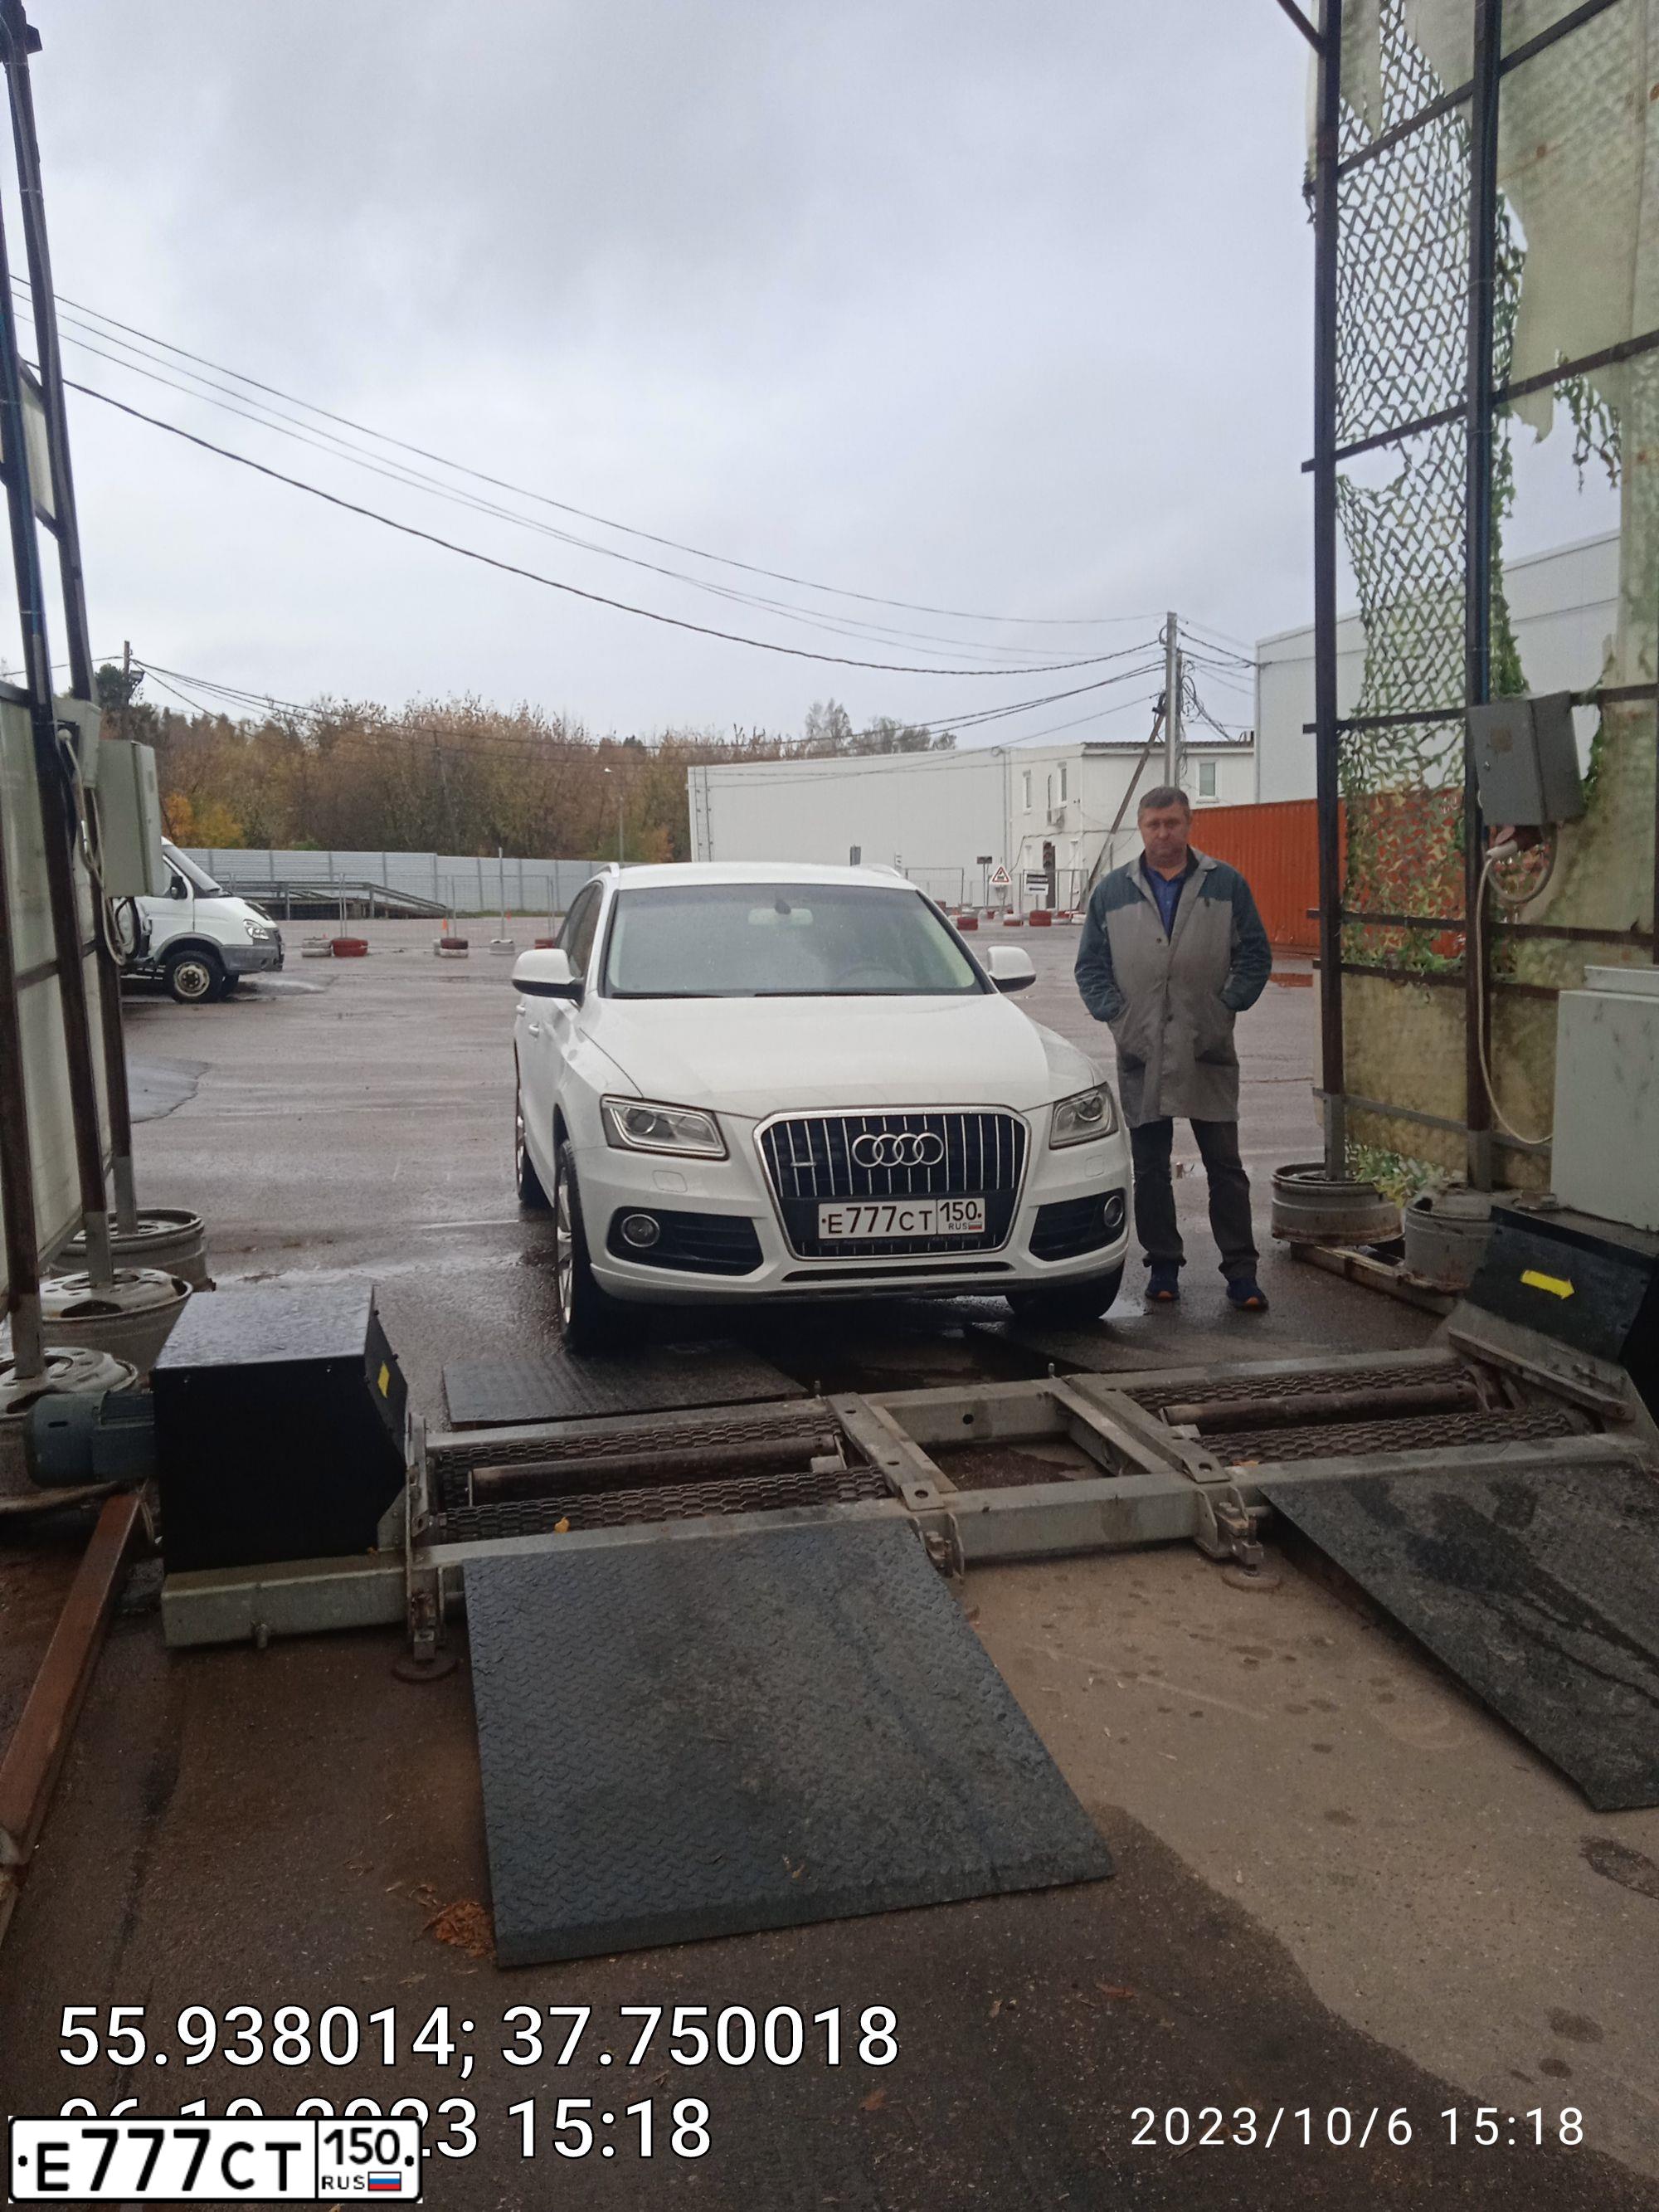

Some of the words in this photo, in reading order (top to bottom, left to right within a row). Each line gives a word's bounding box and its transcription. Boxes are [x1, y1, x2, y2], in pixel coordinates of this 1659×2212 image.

[828, 1206, 932, 1234] Е777СТ
[939, 1201, 978, 1222] 150
[948, 1222, 968, 1230] RUS
